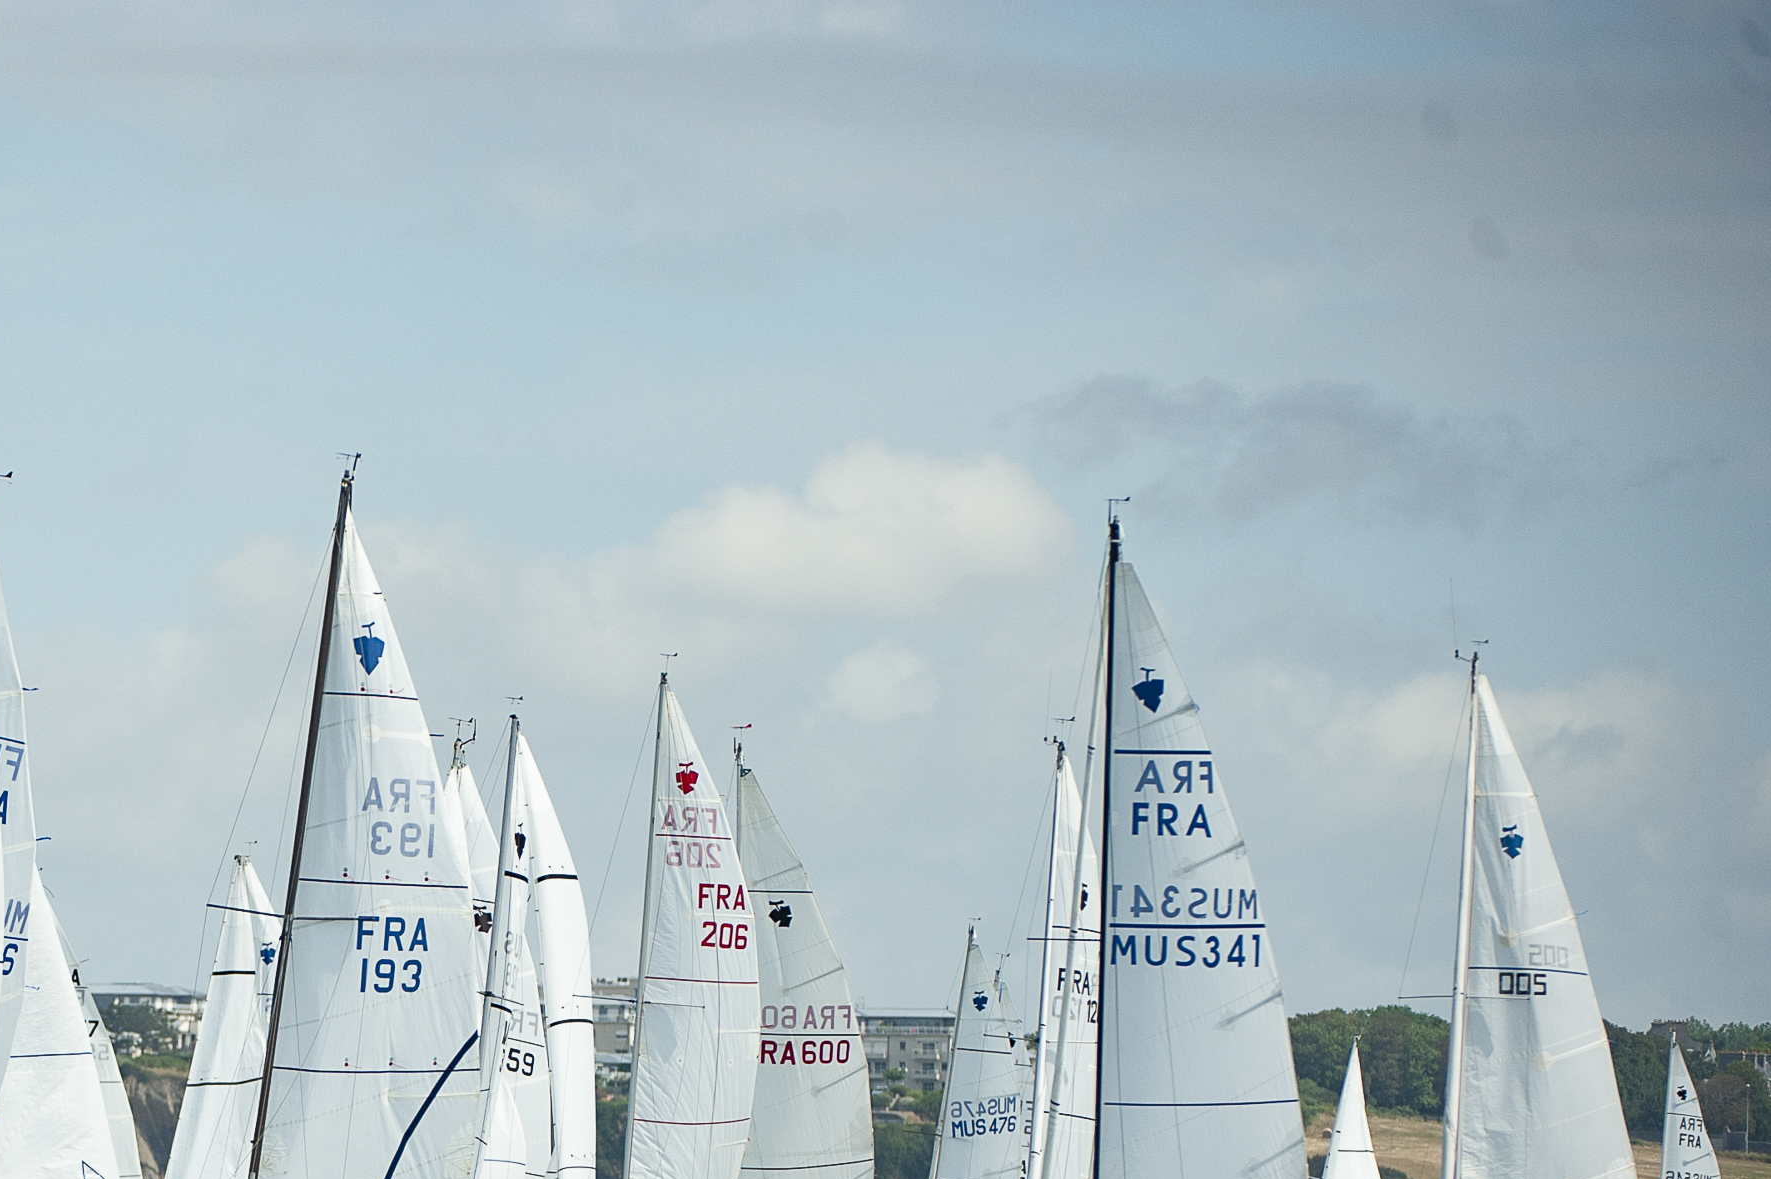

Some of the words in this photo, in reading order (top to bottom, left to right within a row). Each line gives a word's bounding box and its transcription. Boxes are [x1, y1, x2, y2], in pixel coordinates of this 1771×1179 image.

[1131, 801, 1212, 838] FRA
[698, 882, 746, 911] FRA
[356, 915, 429, 952] FRA
[700, 920, 749, 950] 206
[1110, 933, 1261, 969] MUS341
[359, 957, 423, 993] 193
[1499, 972, 1547, 996] 005
[500, 1047, 535, 1077] 59
[1678, 1133, 1702, 1149] FRA
